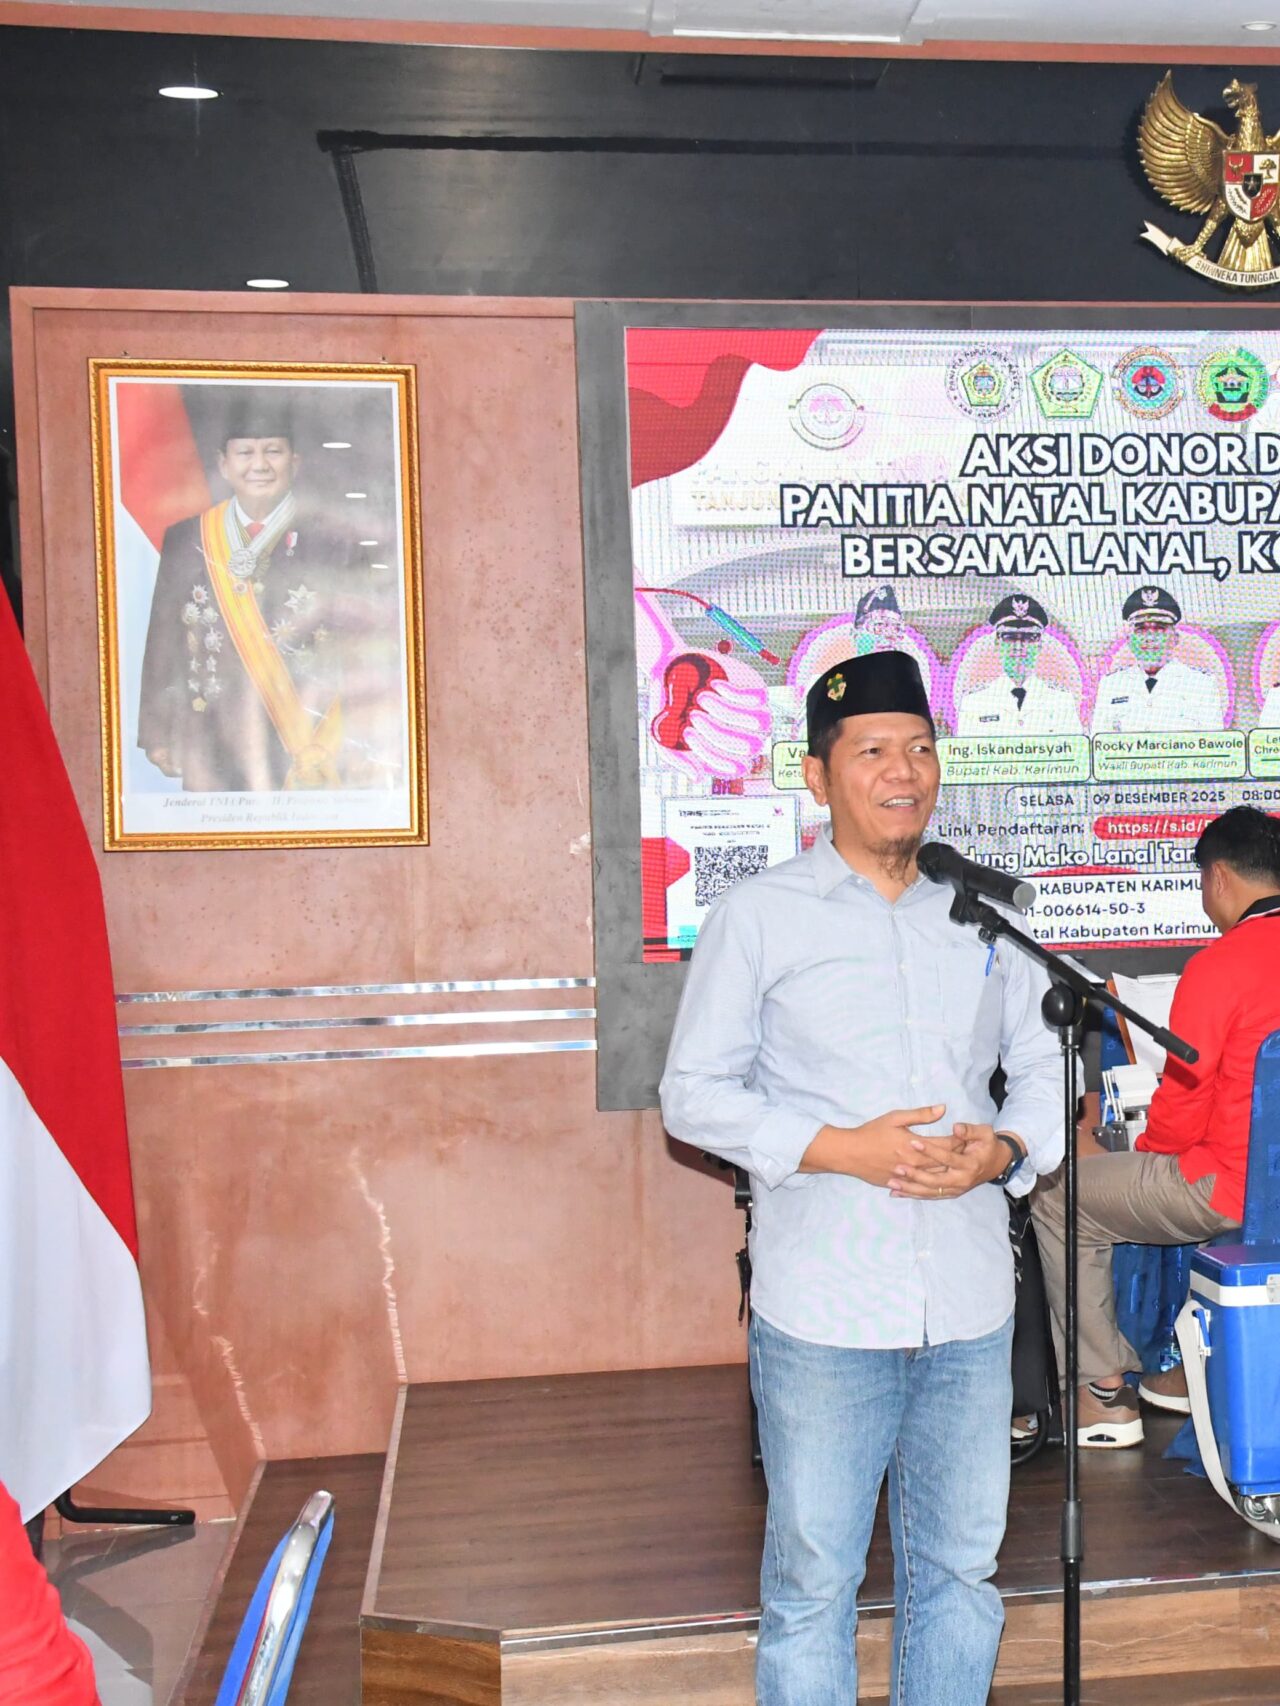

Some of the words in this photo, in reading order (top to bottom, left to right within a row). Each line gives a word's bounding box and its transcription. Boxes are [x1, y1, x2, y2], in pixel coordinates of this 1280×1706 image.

[1240, 273, 1279, 283] TUNGGAL
[960, 434, 1073, 476] AKSI
[1081, 433, 1252, 476] DONOR
[780, 484, 965, 527] PANITIA
[967, 483, 1115, 526] NATAL
[841, 534, 1064, 577] BERSAMA
[1064, 532, 1230, 581] LANAL,
[948, 743, 973, 758] Ing.
[976, 742, 1073, 758] Iskandarsyah
[1094, 740, 1133, 753] Rocky
[1136, 739, 1196, 751] Marciano
[1198, 738, 1244, 750] Bawole
[947, 765, 990, 777] Bupati
[992, 764, 1023, 776] Kab.
[1025, 763, 1080, 775] Karimun
[1097, 761, 1128, 771] Wakil
[1130, 760, 1166, 771] Bupati
[1167, 759, 1190, 769] Kab.
[1193, 759, 1238, 769] Karimun
[1020, 795, 1074, 806] SELASA
[1093, 793, 1110, 805] 09
[1114, 791, 1188, 804] DESEMBER
[1191, 790, 1226, 802] 2025
[938, 824, 973, 837] Link
[977, 822, 1085, 836] Pendaftaran:
[1023, 843, 1089, 868] Mako
[1092, 841, 1155, 866] Lanal
[1040, 881, 1139, 896] KABUPATEN
[1142, 879, 1203, 892] KARIMU
[1024, 902, 1146, 917] 1-006614-50-3
[1033, 927, 1054, 939] tal
[1059, 924, 1149, 940] Kabupaten
